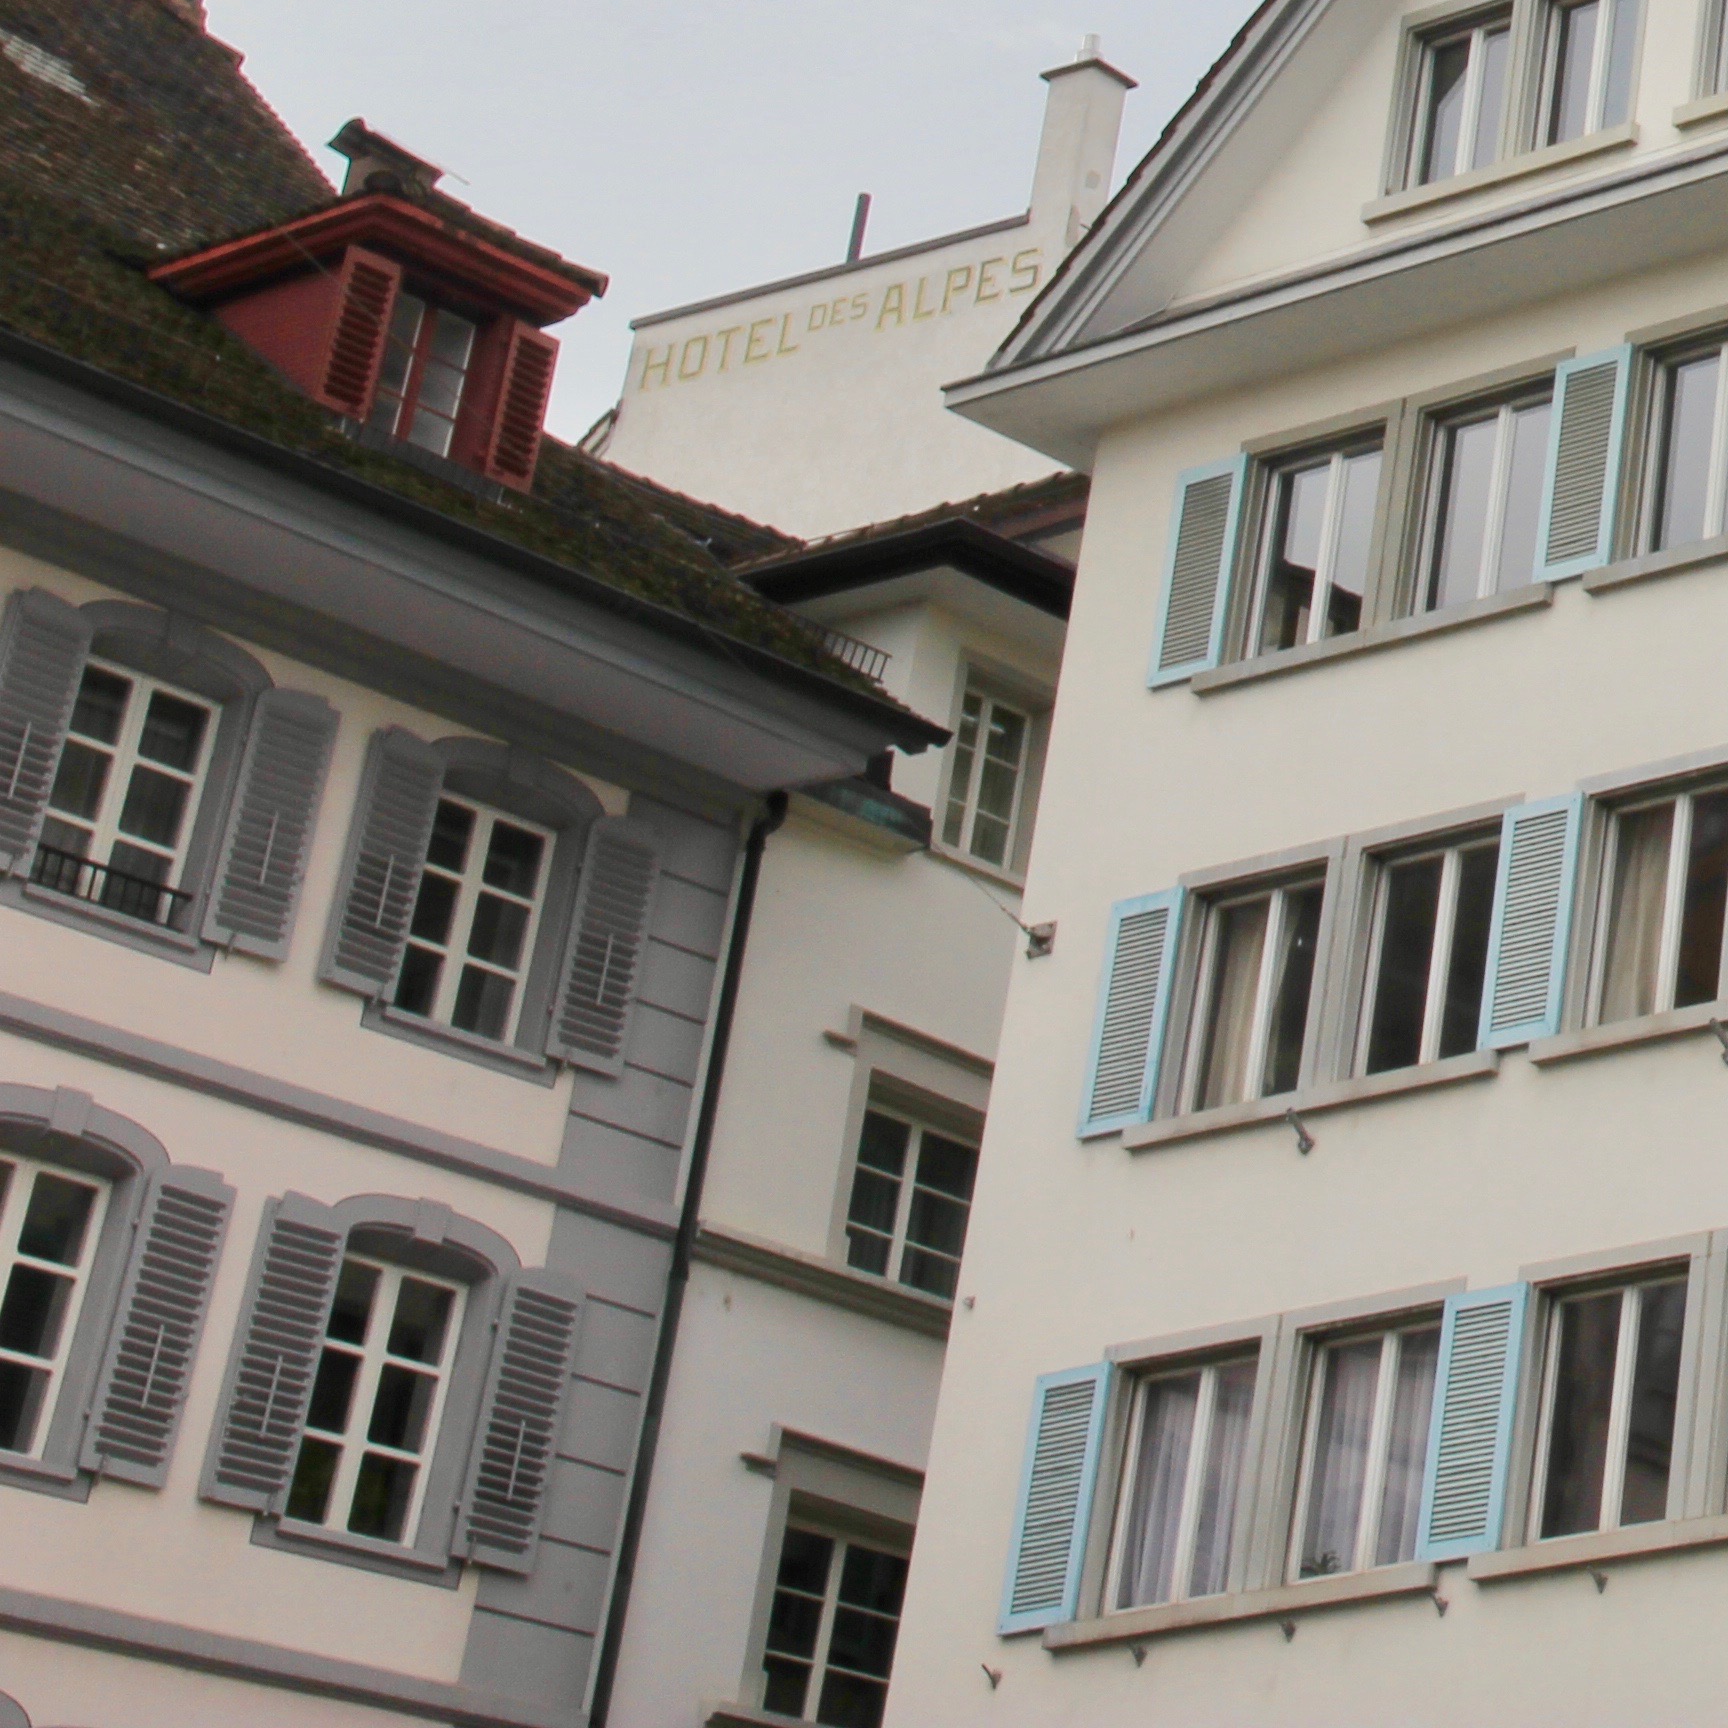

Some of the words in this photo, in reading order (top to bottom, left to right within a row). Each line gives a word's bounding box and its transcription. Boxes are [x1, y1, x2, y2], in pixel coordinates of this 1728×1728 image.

[639, 312, 800, 392] HOTEL
[807, 292, 869, 331] DES
[874, 247, 1043, 333] ALPES
